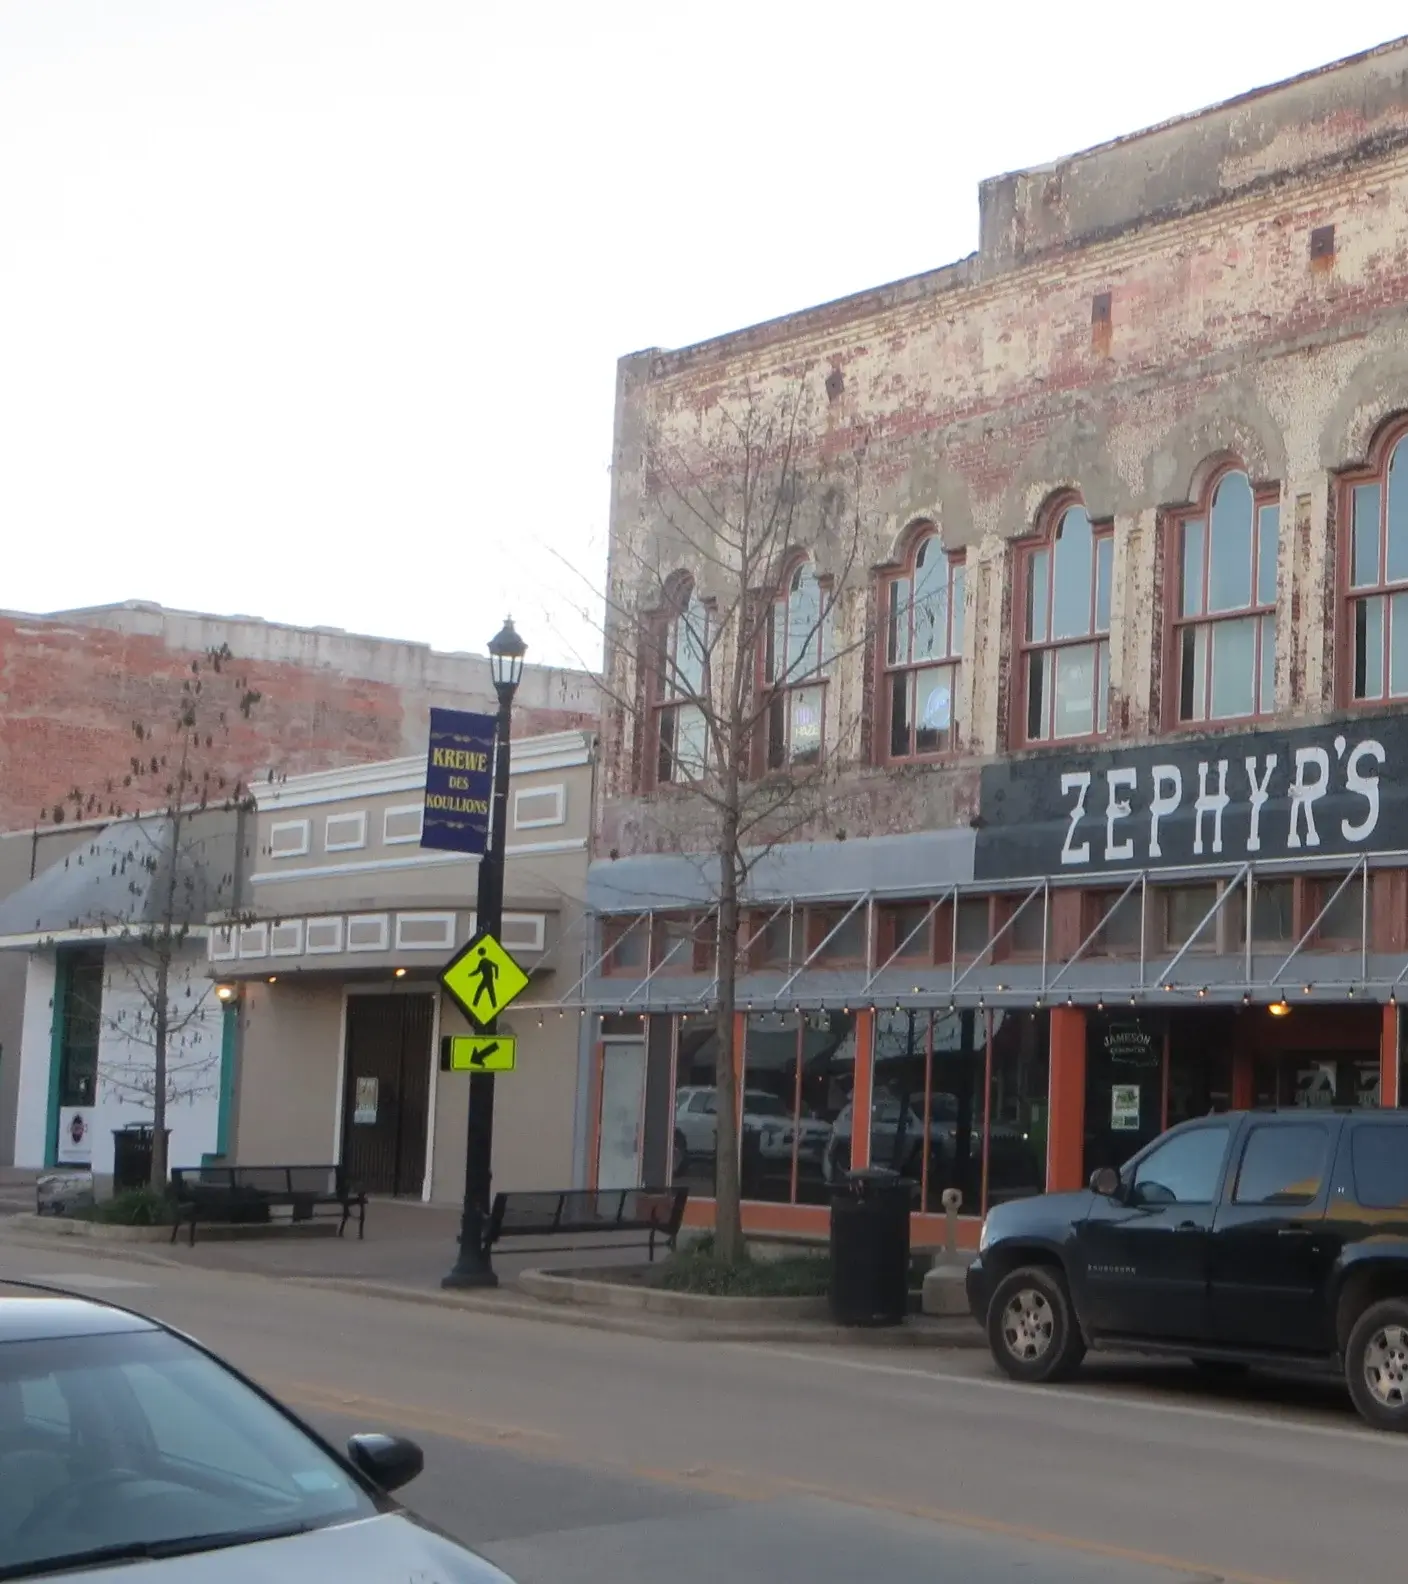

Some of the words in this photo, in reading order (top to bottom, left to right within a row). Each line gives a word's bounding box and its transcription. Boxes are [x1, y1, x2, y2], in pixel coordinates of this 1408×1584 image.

[432, 747, 488, 772] KREWE
[448, 775, 470, 790] DES
[426, 793, 488, 815] KOULLIONS
[1060, 735, 1386, 865] ZEPHYR'S
